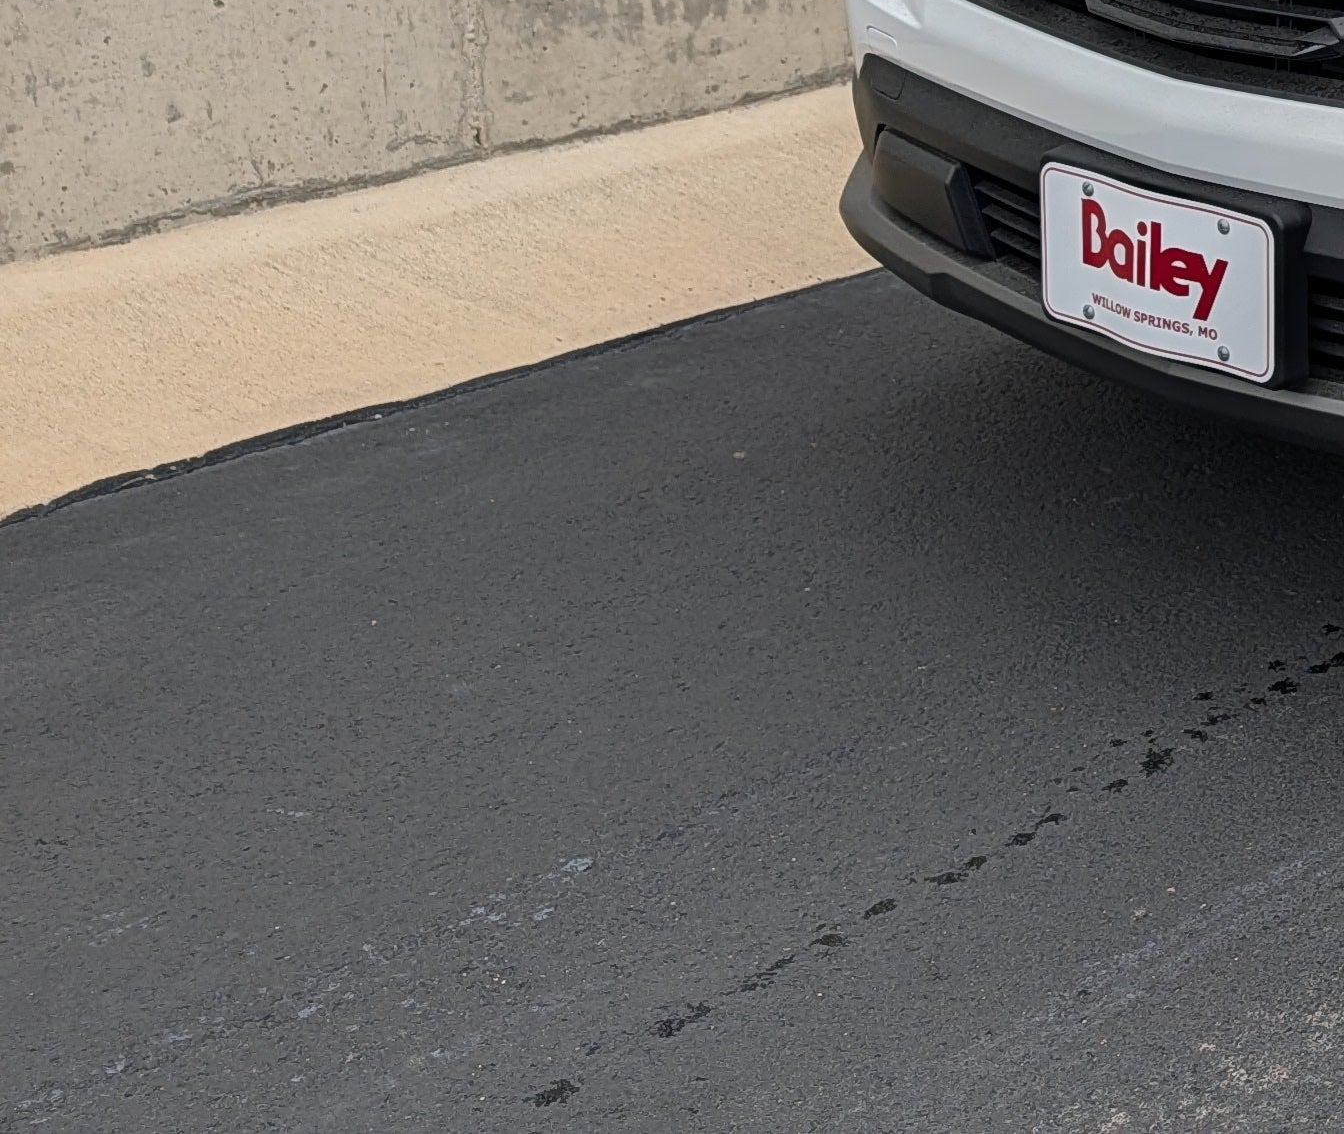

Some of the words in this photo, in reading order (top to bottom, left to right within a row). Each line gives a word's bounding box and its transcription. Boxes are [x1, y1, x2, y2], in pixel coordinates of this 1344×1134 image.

[1080, 197, 1229, 322] Bailey
[1091, 292, 1132, 320] WILLOW
[1133, 310, 1194, 337] SPRINGS,
[1197, 325, 1219, 341] MO
